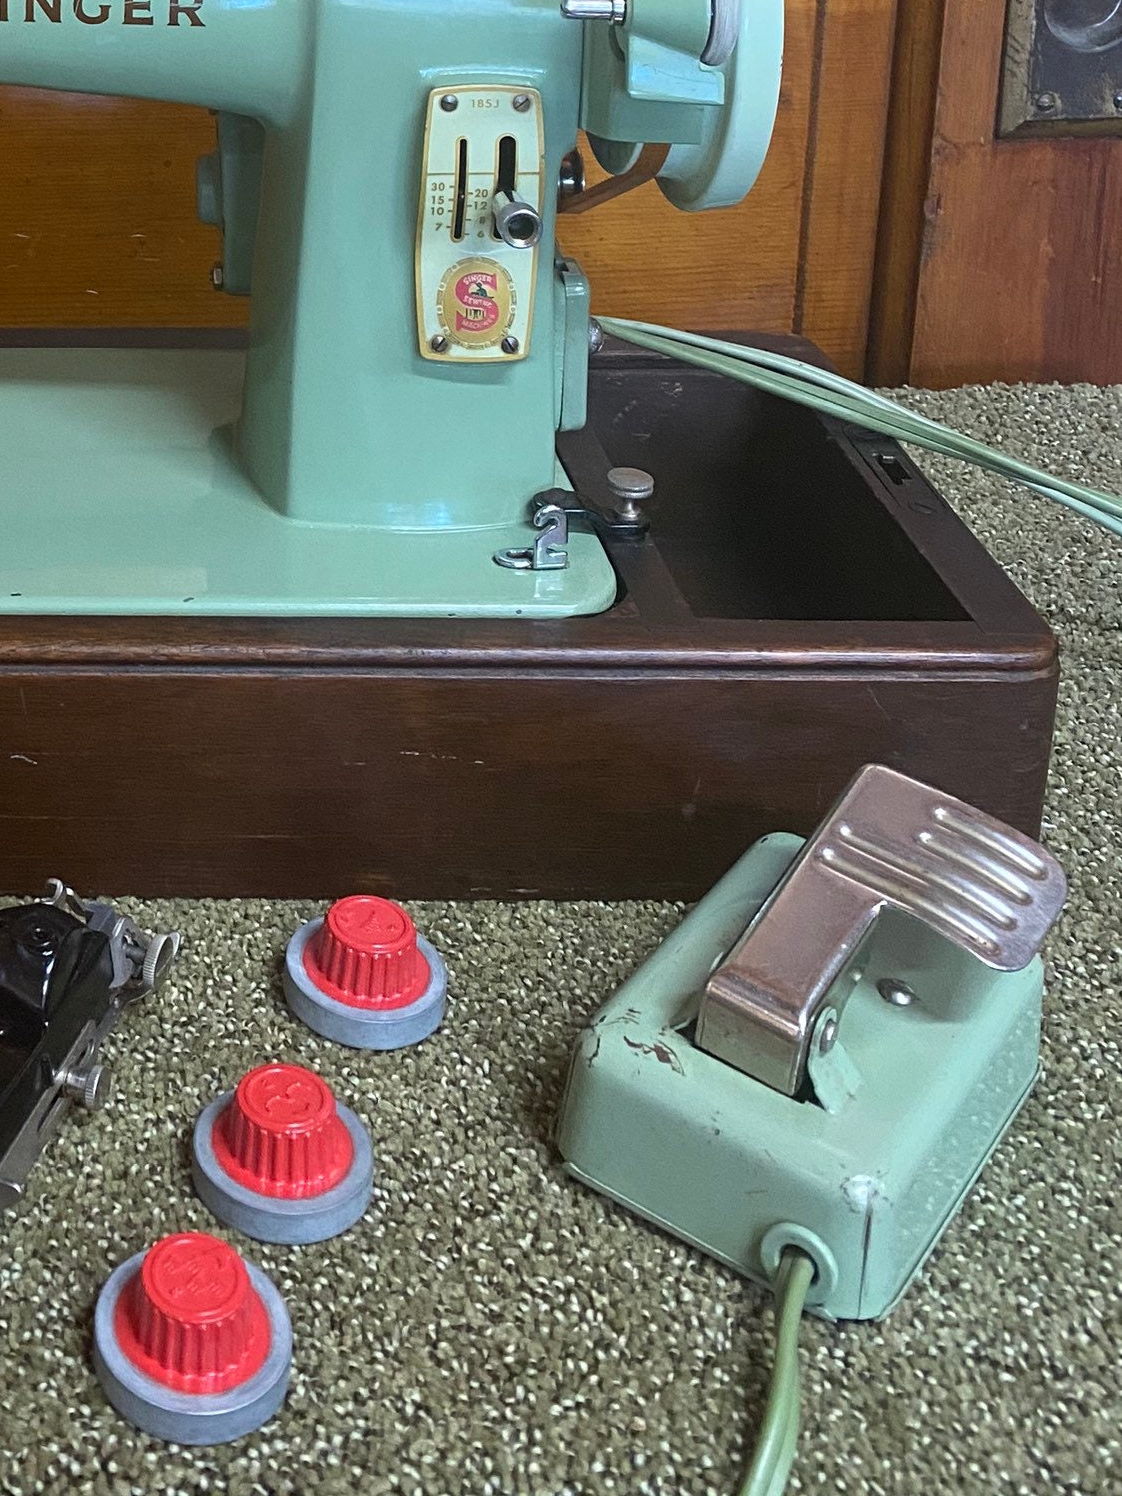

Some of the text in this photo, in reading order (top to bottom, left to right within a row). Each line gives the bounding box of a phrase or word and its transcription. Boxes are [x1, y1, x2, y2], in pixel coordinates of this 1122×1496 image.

[471, 99, 500, 108] 185J
[431, 183, 445, 191] 30
[475, 189, 489, 197] 20
[431, 196, 445, 204] 15
[474, 202, 488, 210] 12
[431, 207, 445, 215] 10
[435, 223, 443, 231] 7
